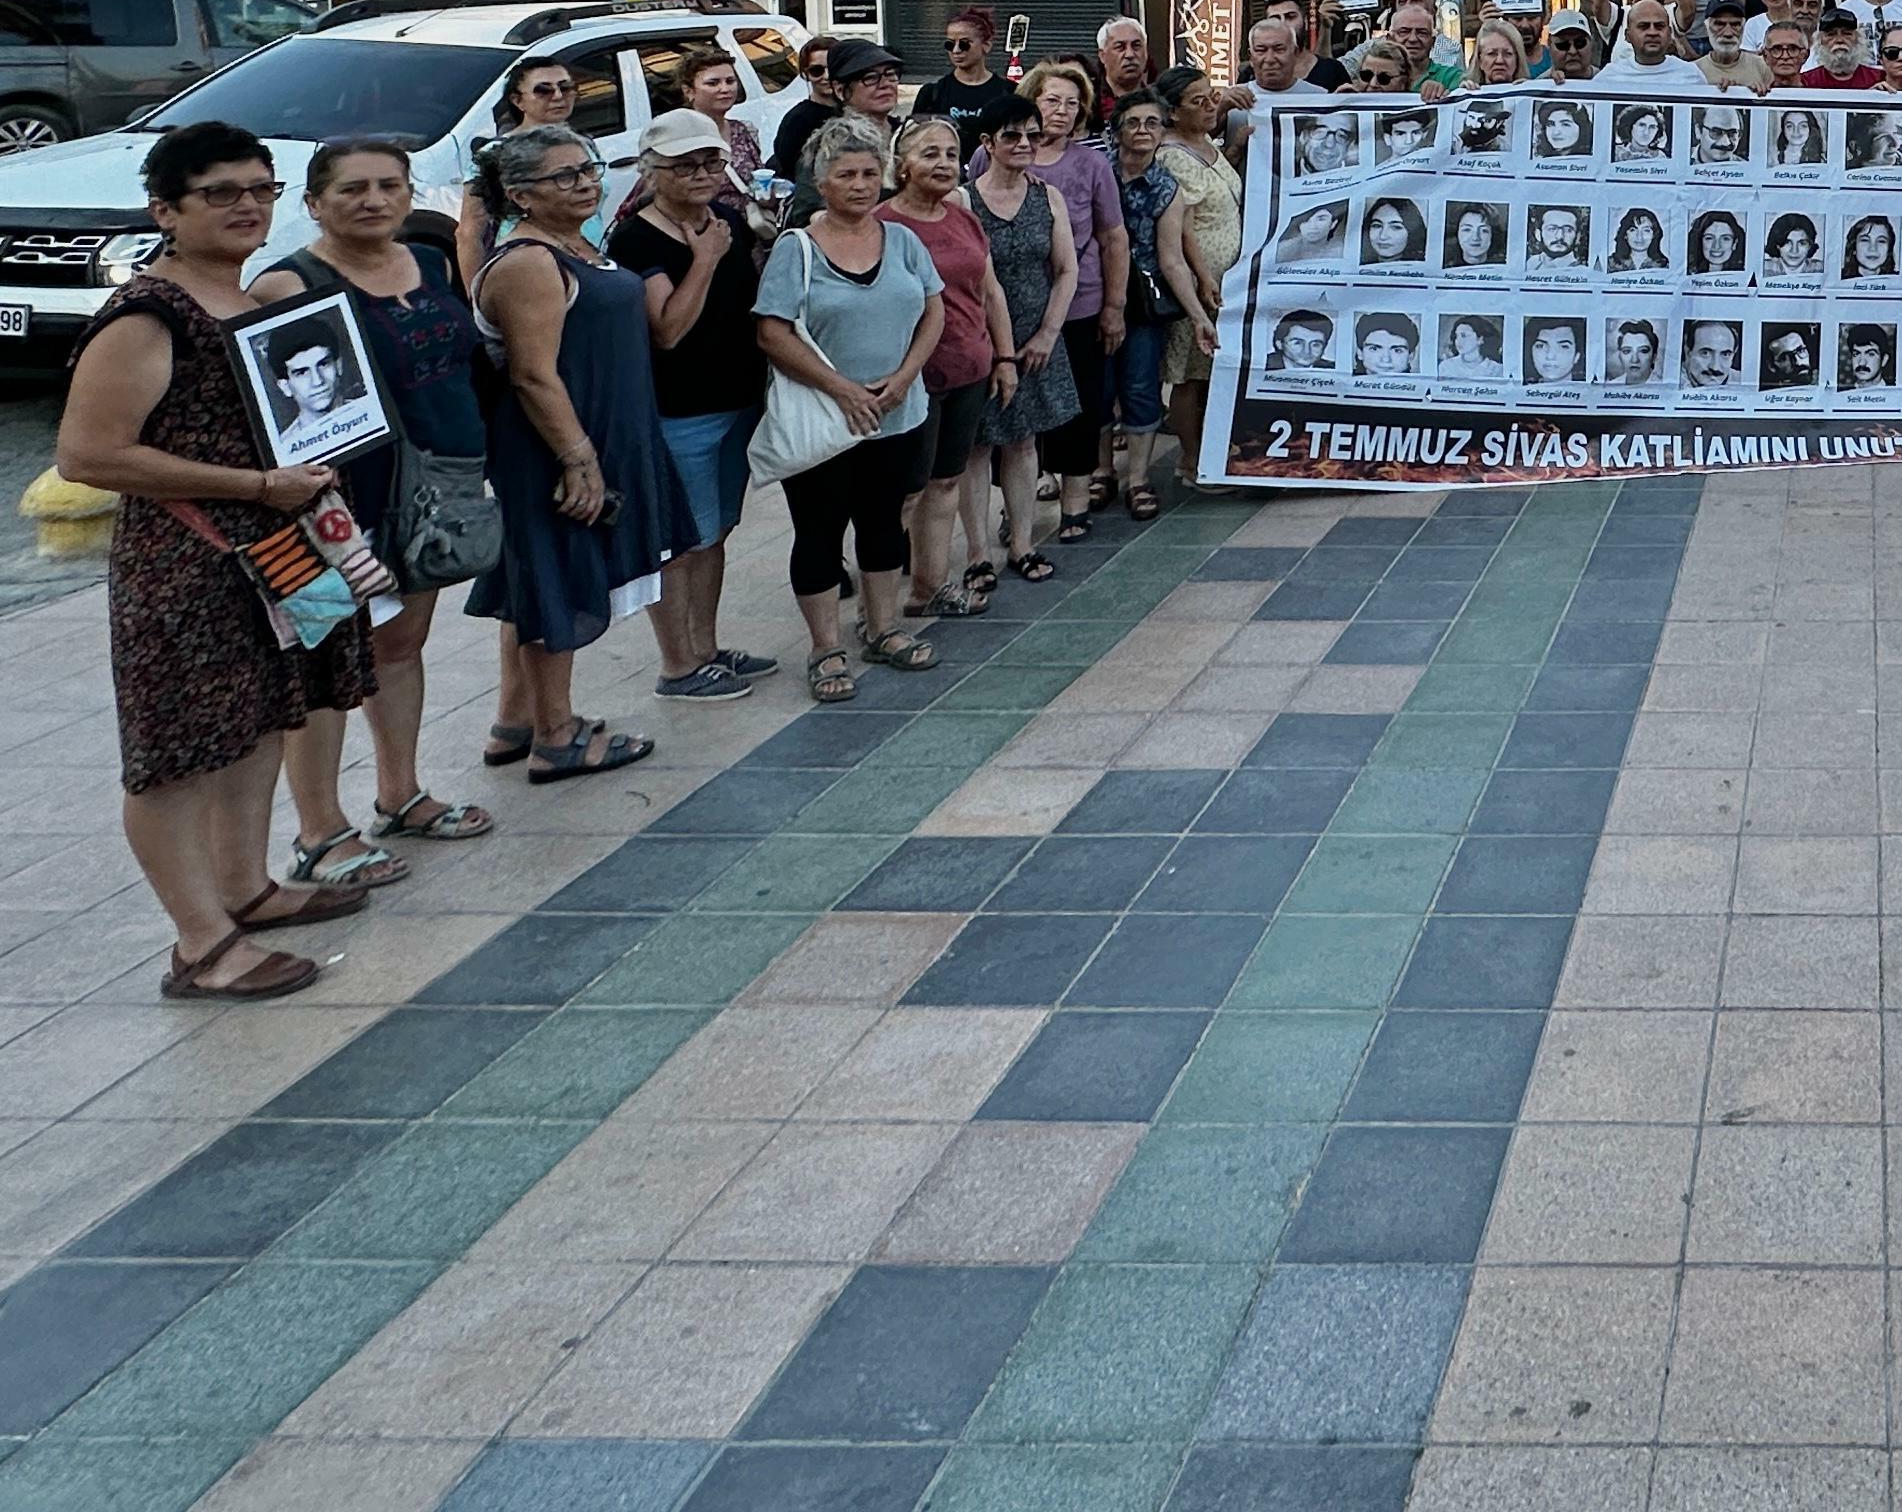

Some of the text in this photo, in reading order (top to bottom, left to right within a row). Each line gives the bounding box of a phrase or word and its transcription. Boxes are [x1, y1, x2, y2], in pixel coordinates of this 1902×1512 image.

[1210, 3, 1232, 88] HMET
[289, 412, 369, 453] Ahmet Özyurt
[1266, 420, 1292, 457] 2
[1304, 422, 1474, 465] TEMMUZ
[1482, 423, 1589, 468] SİVAS
[1601, 426, 1809, 468] KATLİAMINI
